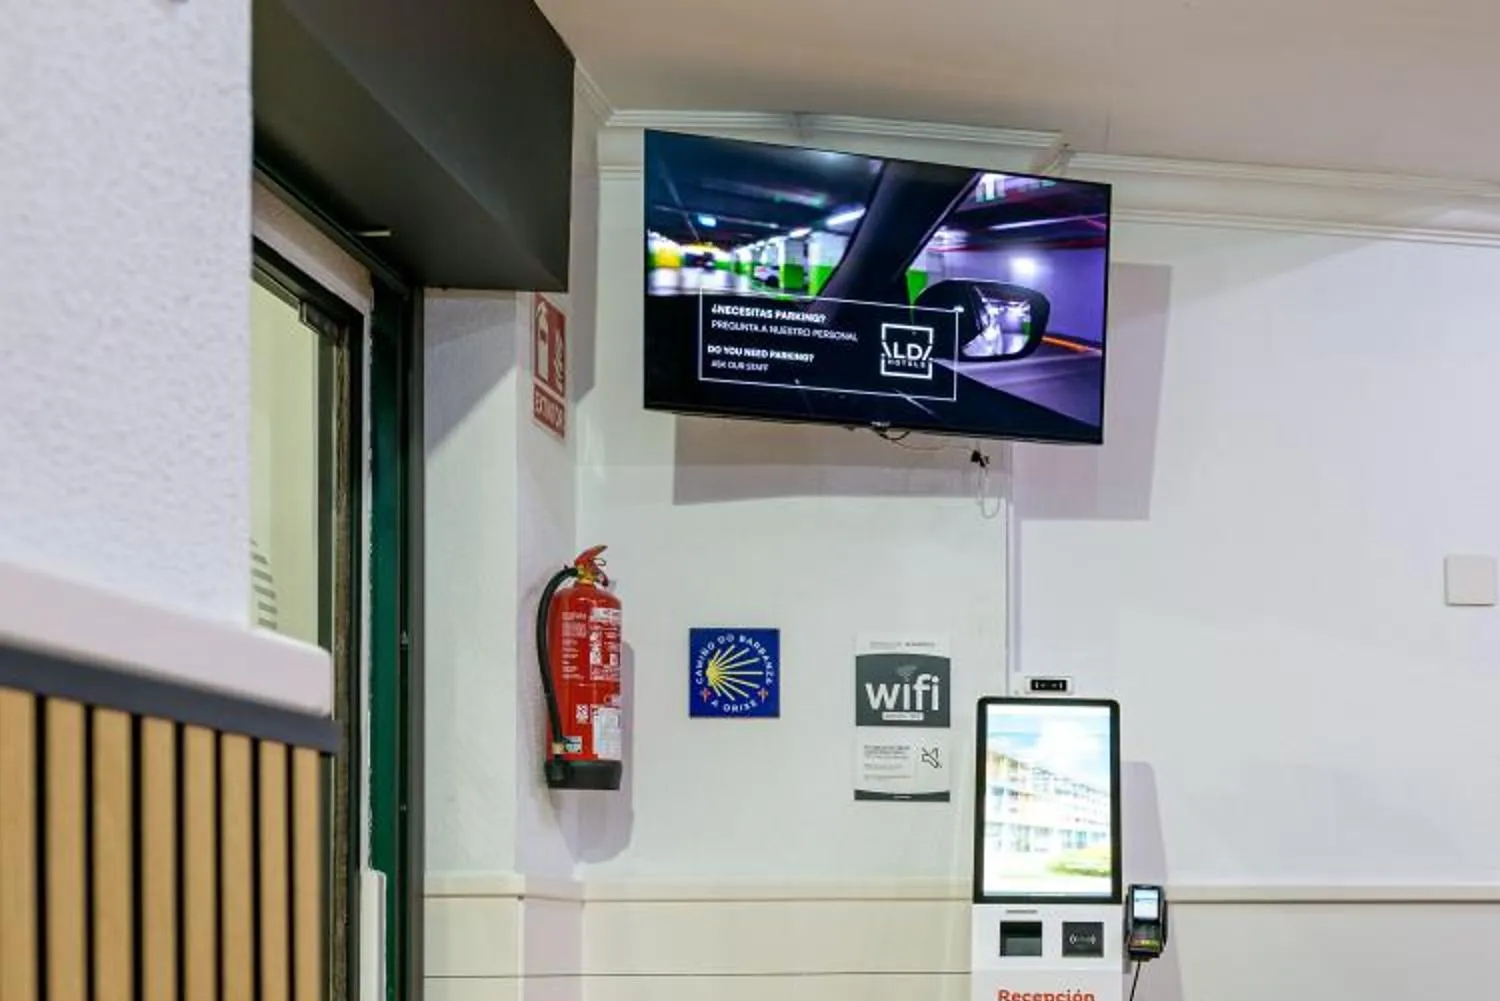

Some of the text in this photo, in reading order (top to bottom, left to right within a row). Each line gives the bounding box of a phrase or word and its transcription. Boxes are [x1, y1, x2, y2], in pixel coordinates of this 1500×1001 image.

[711, 303, 773, 319] ¿NECESITAS
[711, 319, 859, 342] PREGUNTA A NUESTRO PERSONAL
[707, 345, 815, 363] DO YOU NEED PARKING?
[864, 673, 940, 711] wifi
